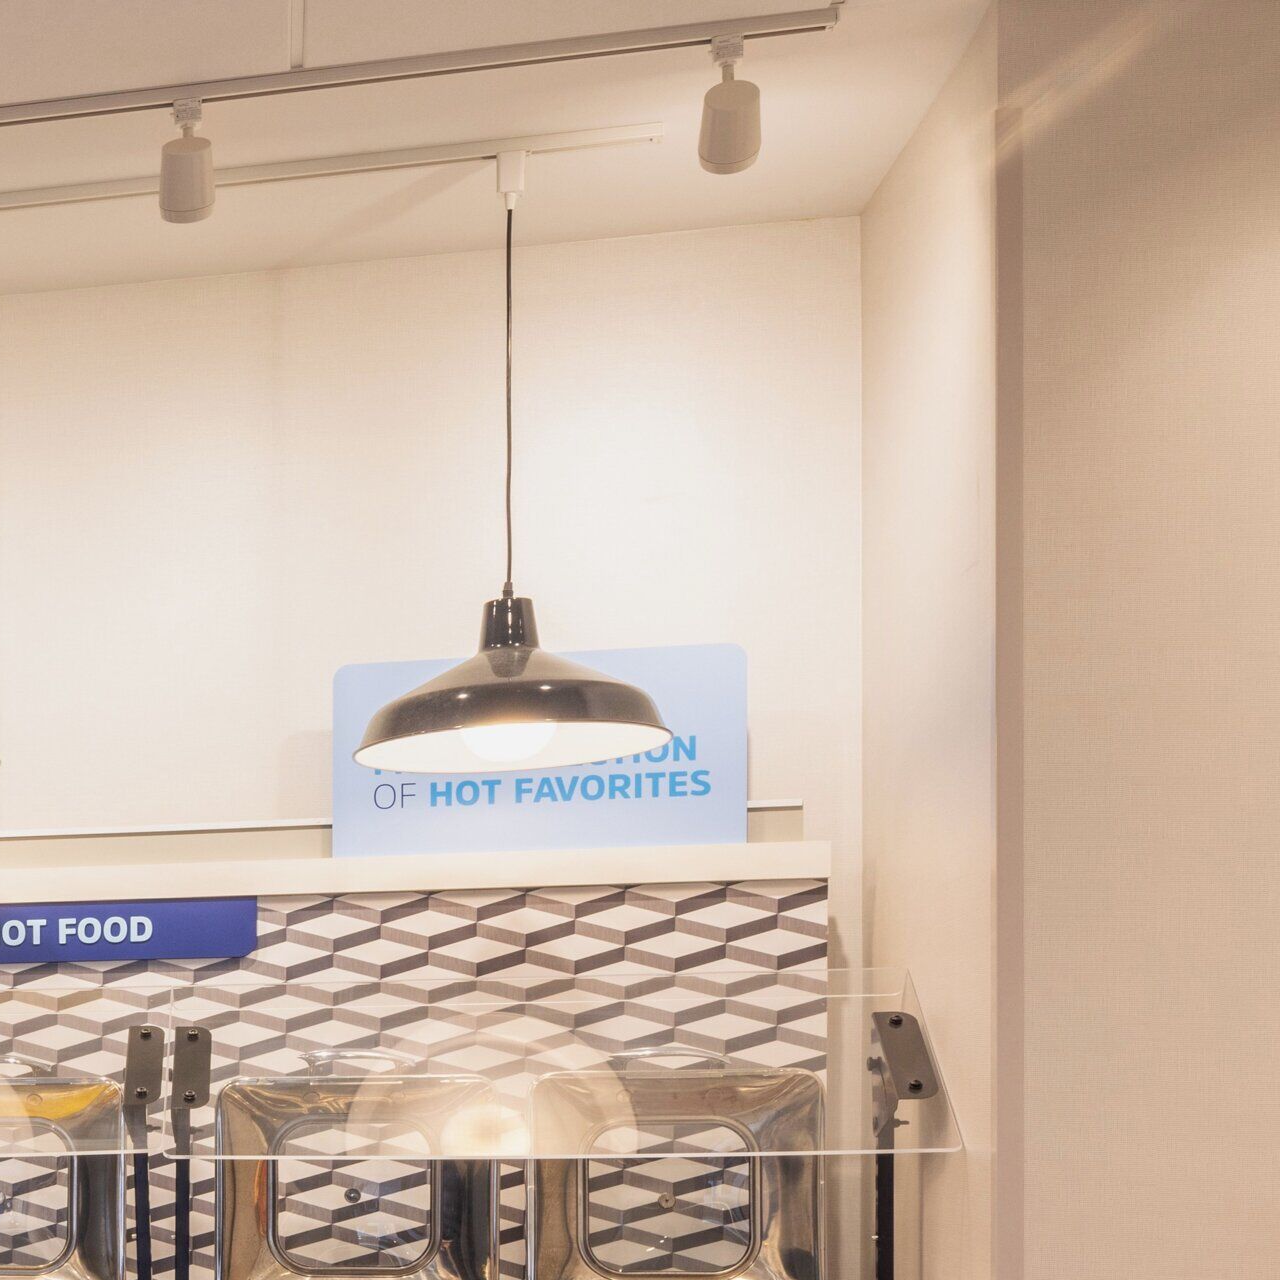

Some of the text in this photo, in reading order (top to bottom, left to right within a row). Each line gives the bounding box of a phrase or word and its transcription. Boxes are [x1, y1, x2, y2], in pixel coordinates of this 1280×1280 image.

[373, 769, 712, 810] OF HOT FAVORITES
[58, 916, 153, 944] FOOD
